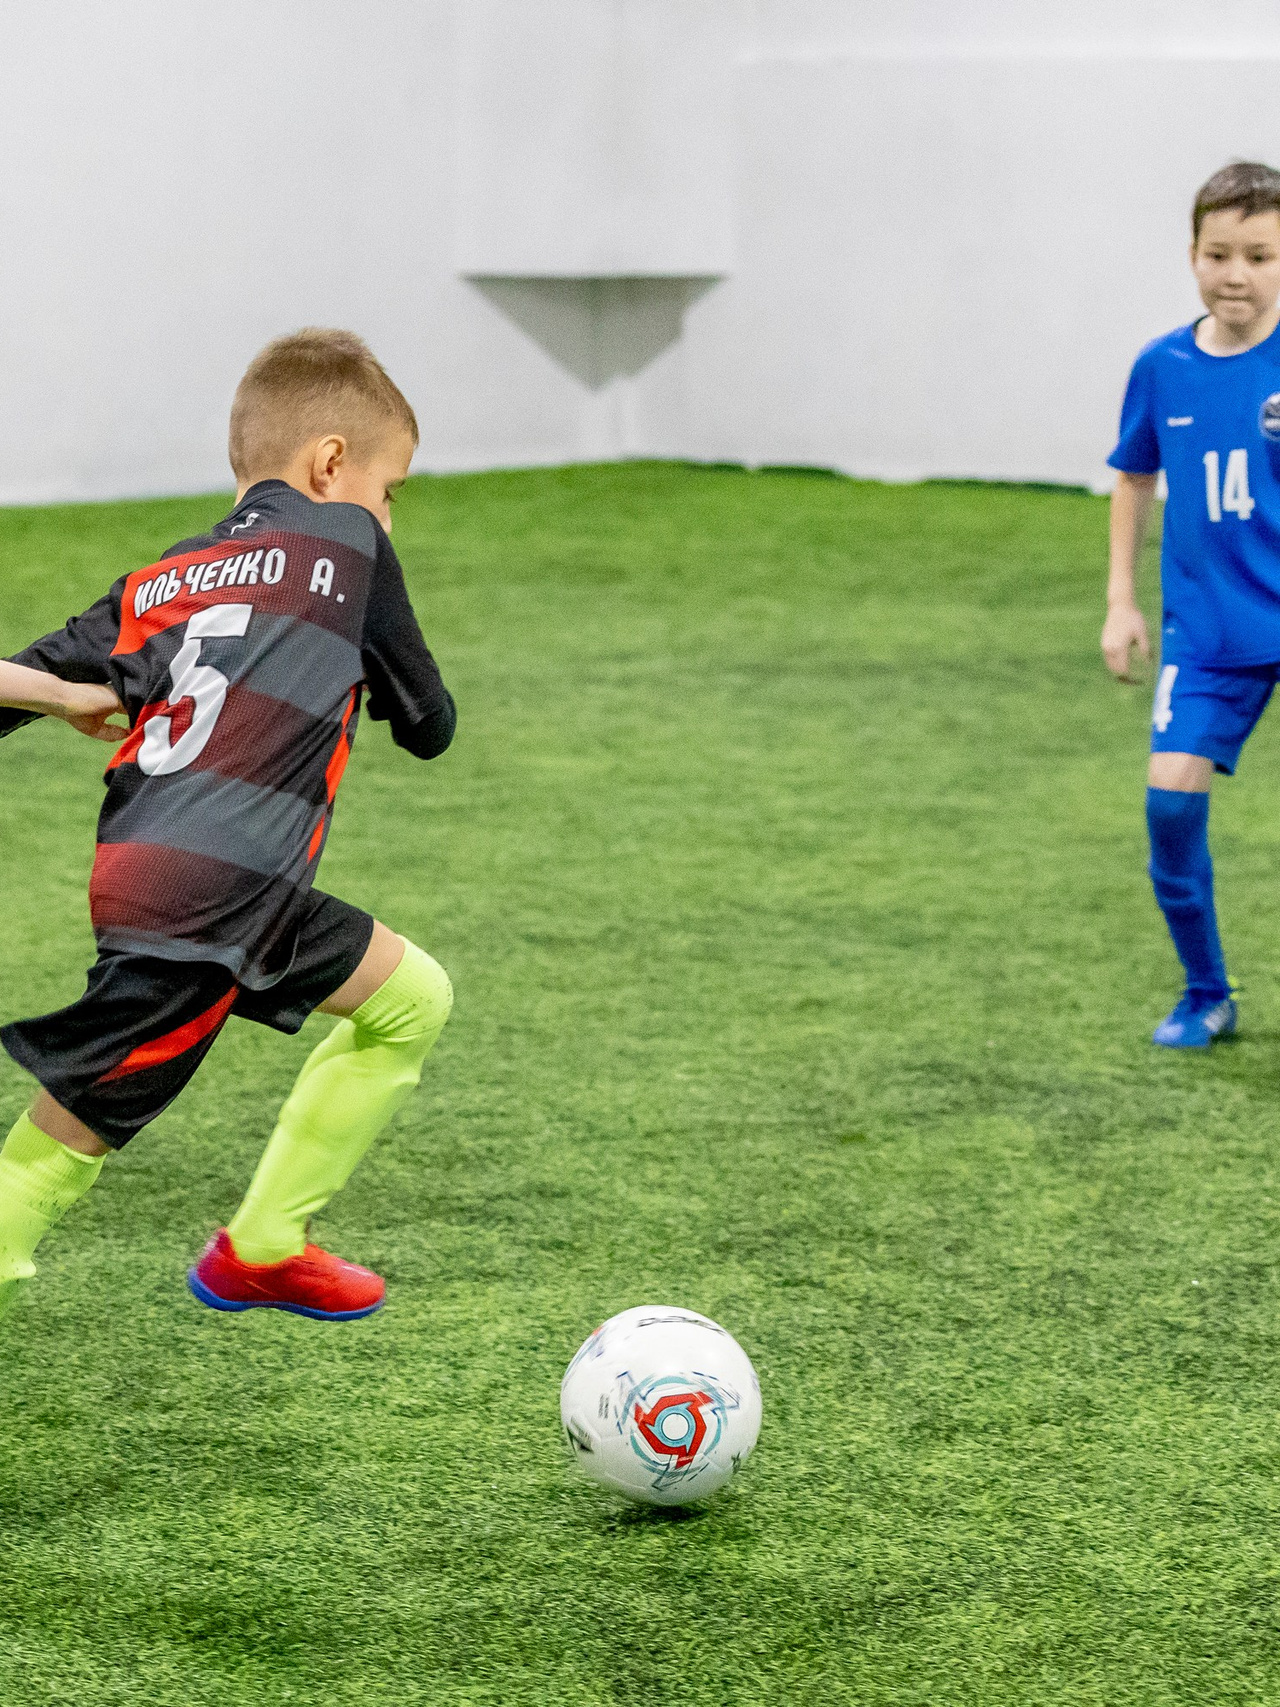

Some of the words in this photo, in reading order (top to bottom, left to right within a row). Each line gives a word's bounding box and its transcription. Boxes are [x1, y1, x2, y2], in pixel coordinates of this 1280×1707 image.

[1202, 448, 1256, 523] 14
[134, 547, 287, 619] ИЛЬЧЕНКО
[137, 604, 253, 776] 5
